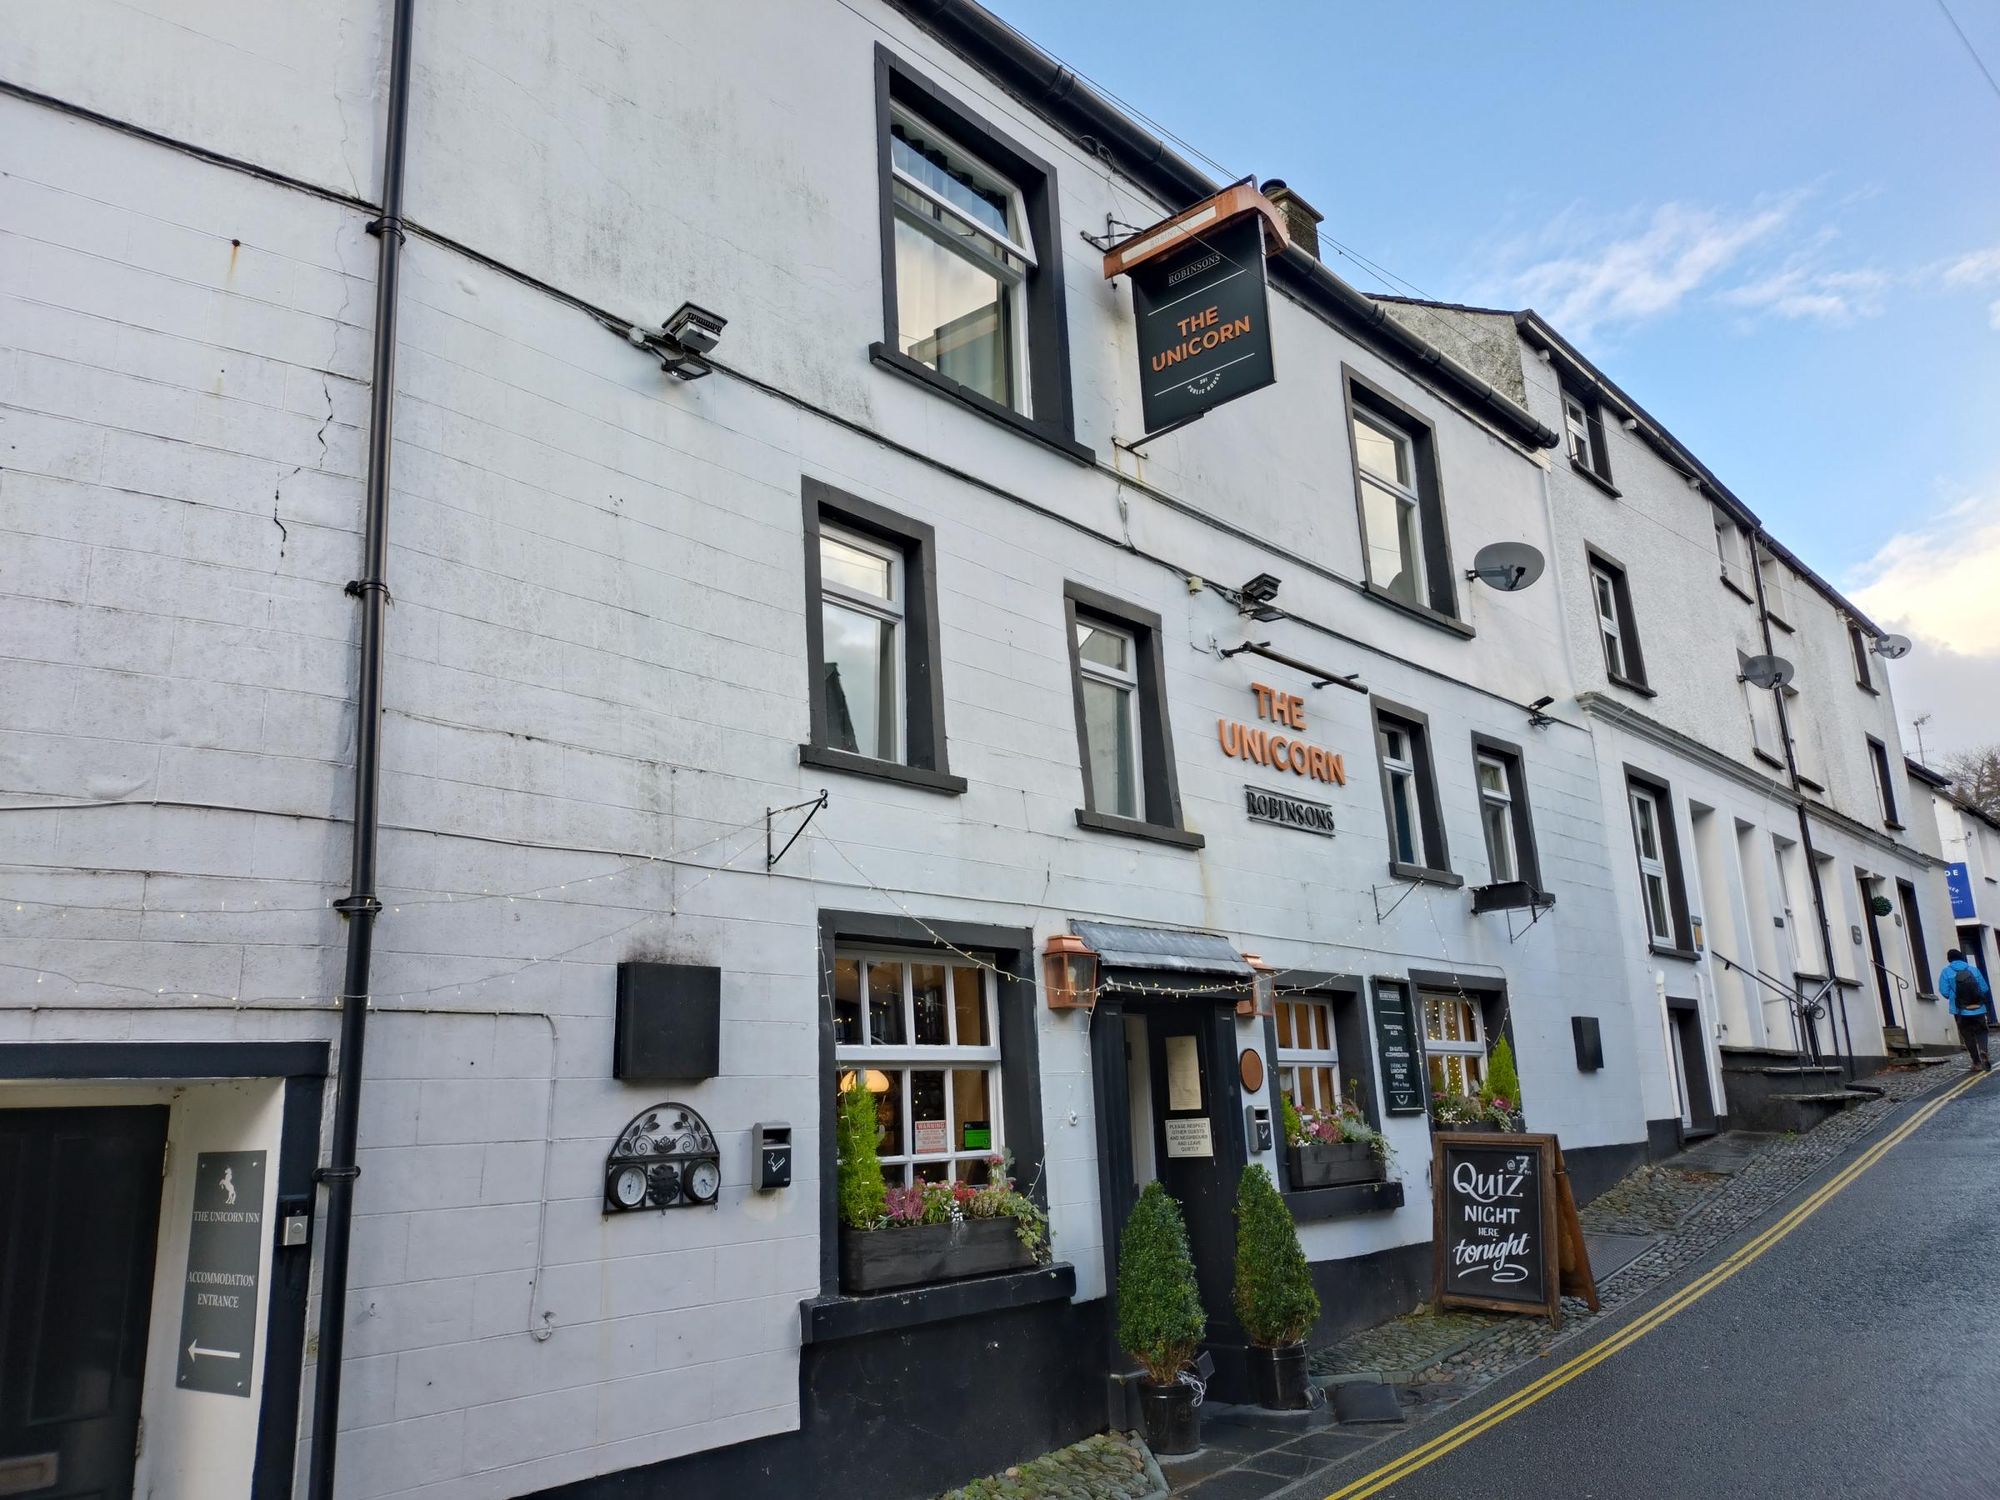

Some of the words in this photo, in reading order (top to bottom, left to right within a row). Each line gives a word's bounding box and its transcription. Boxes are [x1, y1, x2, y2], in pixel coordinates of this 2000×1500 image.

[1168, 254, 1221, 285] ROBINSONS
[1177, 305, 1219, 337] THE
[1152, 315, 1251, 373] UNICORN
[1250, 681, 1308, 731] THE
[1218, 717, 1347, 788] UNICORN
[1245, 789, 1336, 833] ROBINSONS
[1453, 1162, 1524, 1203] Quiz
[193, 1211, 209, 1221] THE
[210, 1211, 243, 1223] UNICORN
[245, 1212, 260, 1223] INN
[1464, 1205, 1520, 1225] NIGHT
[1478, 1227, 1500, 1237] HERE
[1453, 1232, 1530, 1271] tonight
[187, 1271, 255, 1287] ACCOMMODATION
[197, 1293, 240, 1308] ENTRANCE
